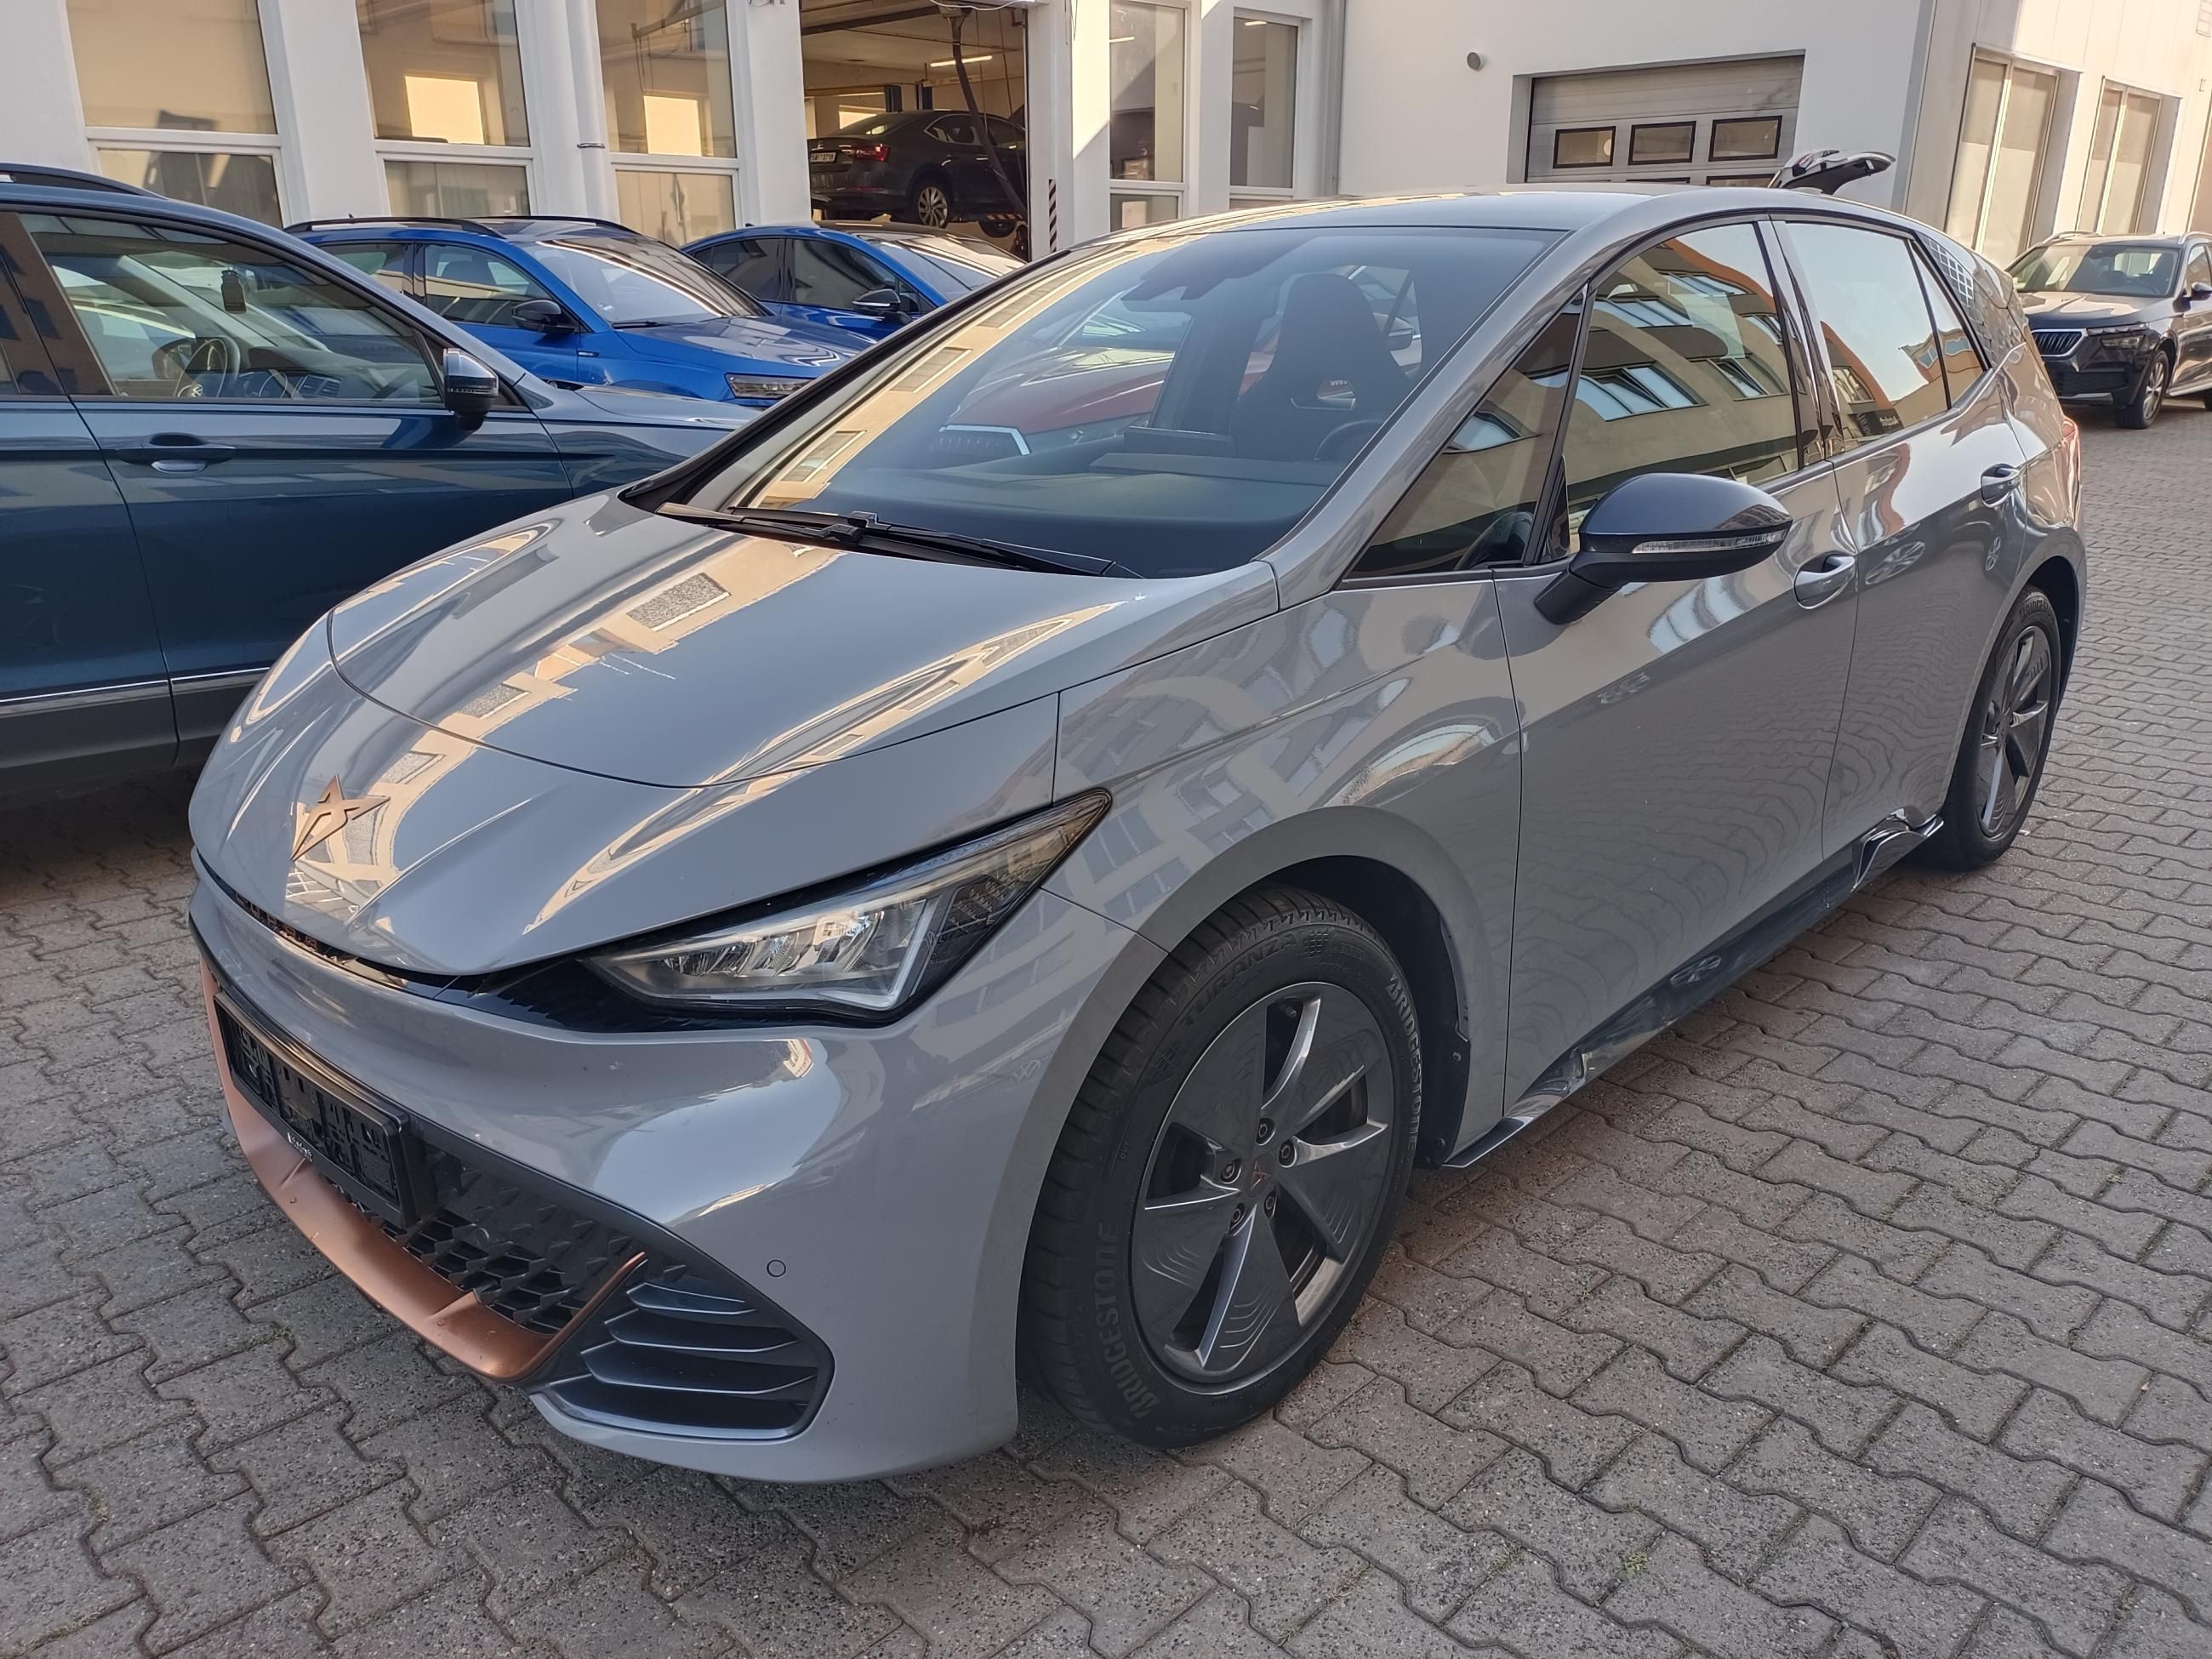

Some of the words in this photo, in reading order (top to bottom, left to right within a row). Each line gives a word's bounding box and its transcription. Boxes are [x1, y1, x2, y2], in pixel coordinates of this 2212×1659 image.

[1179, 932, 1297, 1027] TURANZA
[1384, 972, 1422, 1152] BRIDGESTONE
[1093, 1222, 1160, 1418] BRIDGESTONE
